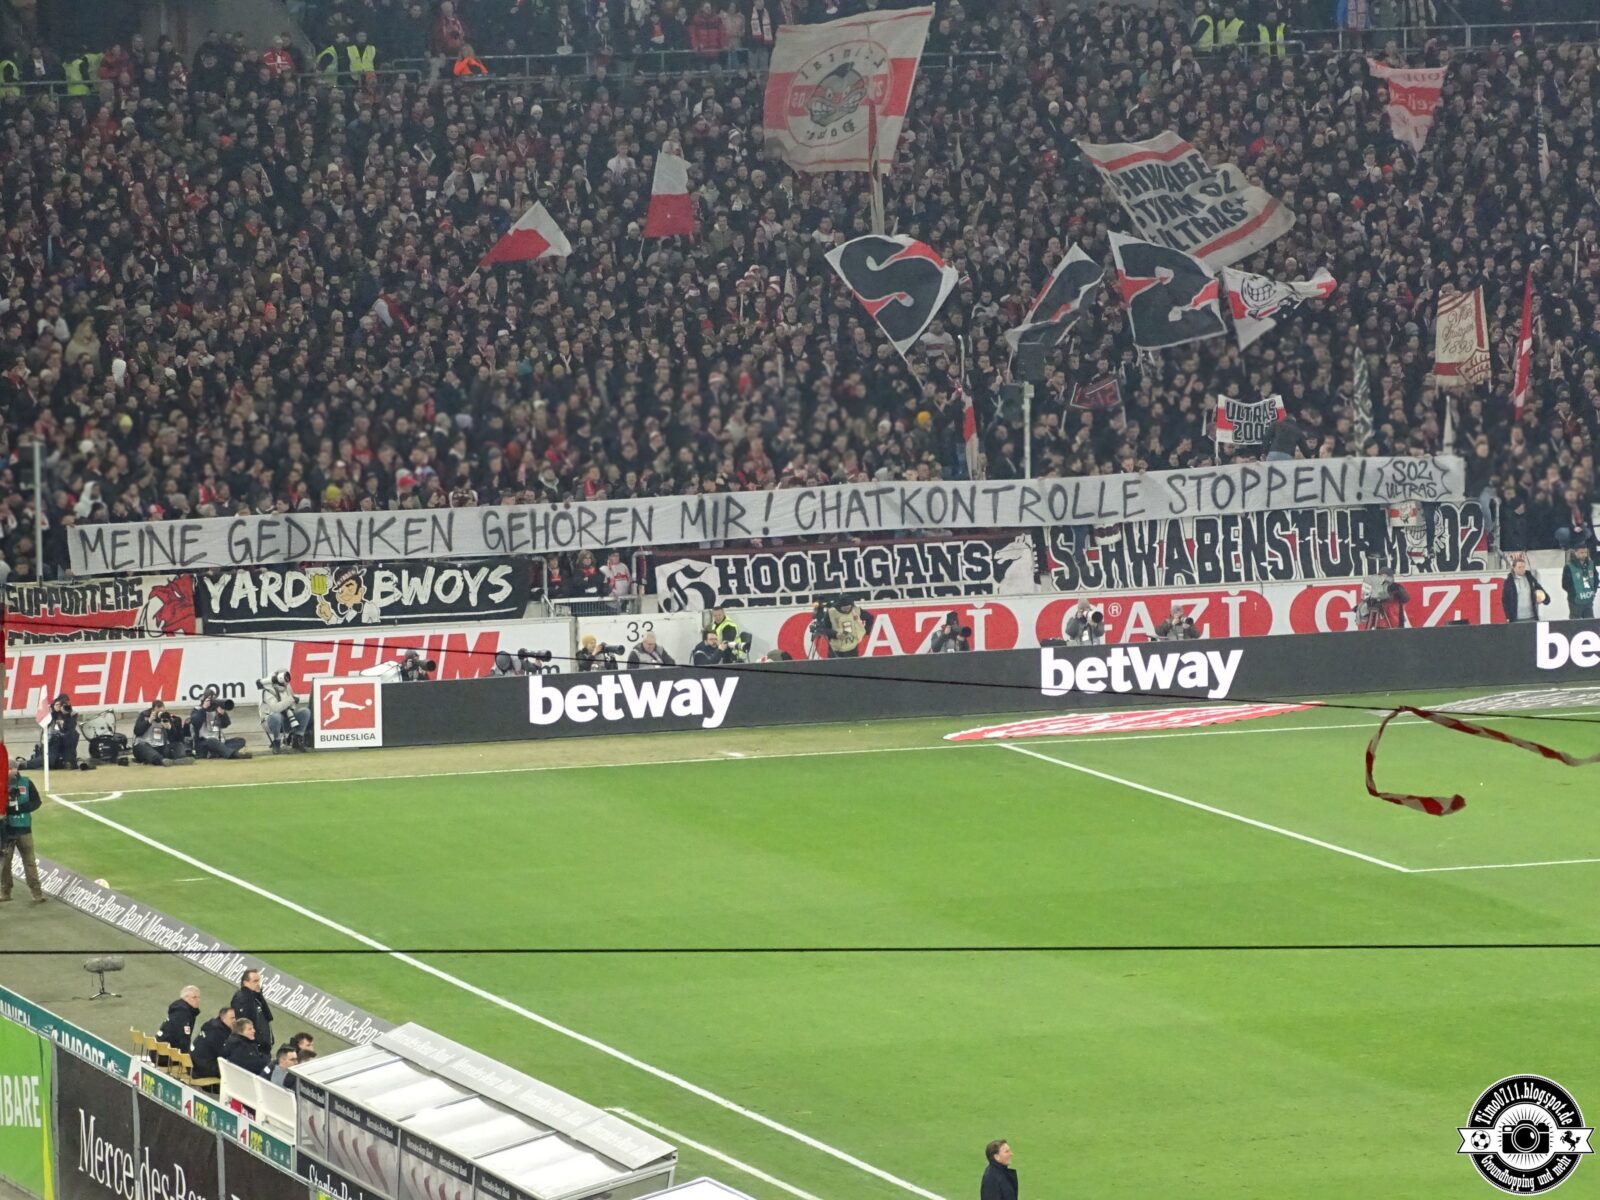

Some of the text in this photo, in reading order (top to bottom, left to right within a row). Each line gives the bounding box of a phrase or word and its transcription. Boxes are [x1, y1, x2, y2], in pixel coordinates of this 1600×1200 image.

[1225, 399, 1277, 422] ULTRAS
[79, 524, 207, 570] MEINE
[228, 511, 455, 563] GEDANKEN
[482, 502, 654, 552] GEHÖREN
[794, 479, 1146, 530] CHATKONTROLLE
[1167, 460, 1367, 514] STOPPEN!
[1385, 482, 1438, 500] ULTRAS
[203, 565, 513, 614] YARD BWOYS
[711, 541, 993, 596] HOOLIGANS
[7, 577, 144, 617] SUPPORTERS
[1041, 647, 1244, 699] betway
[528, 673, 740, 729] betway
[320, 733, 376, 742] BUNDESLIGA
[116, 905, 151, 935] Bank
[281, 985, 318, 1016] Bank
